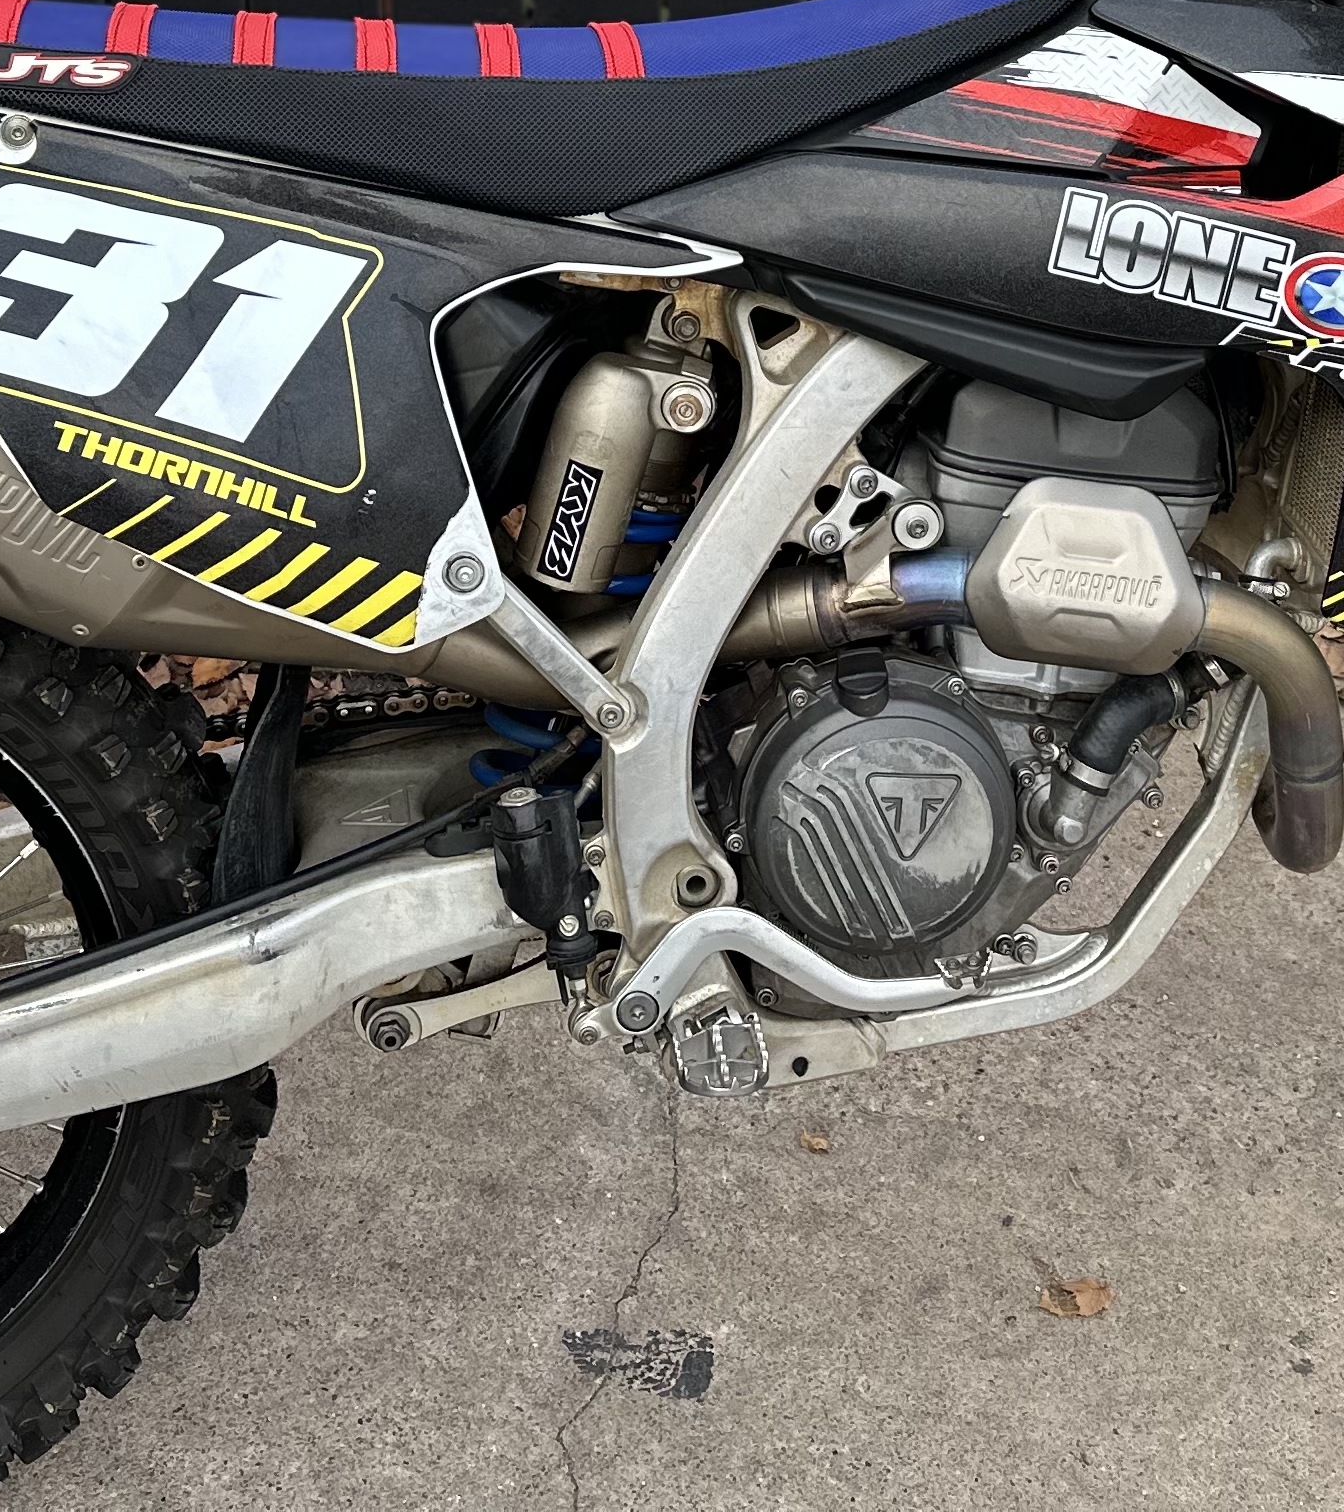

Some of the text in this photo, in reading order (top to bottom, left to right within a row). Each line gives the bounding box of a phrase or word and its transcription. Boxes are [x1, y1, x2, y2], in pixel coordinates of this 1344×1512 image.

[1048, 185, 1284, 326] LONE
[53, 420, 318, 529] THORNHILL
[545, 462, 599, 578] KYB
[1048, 568, 1163, 609] AKRAPOVIČ
